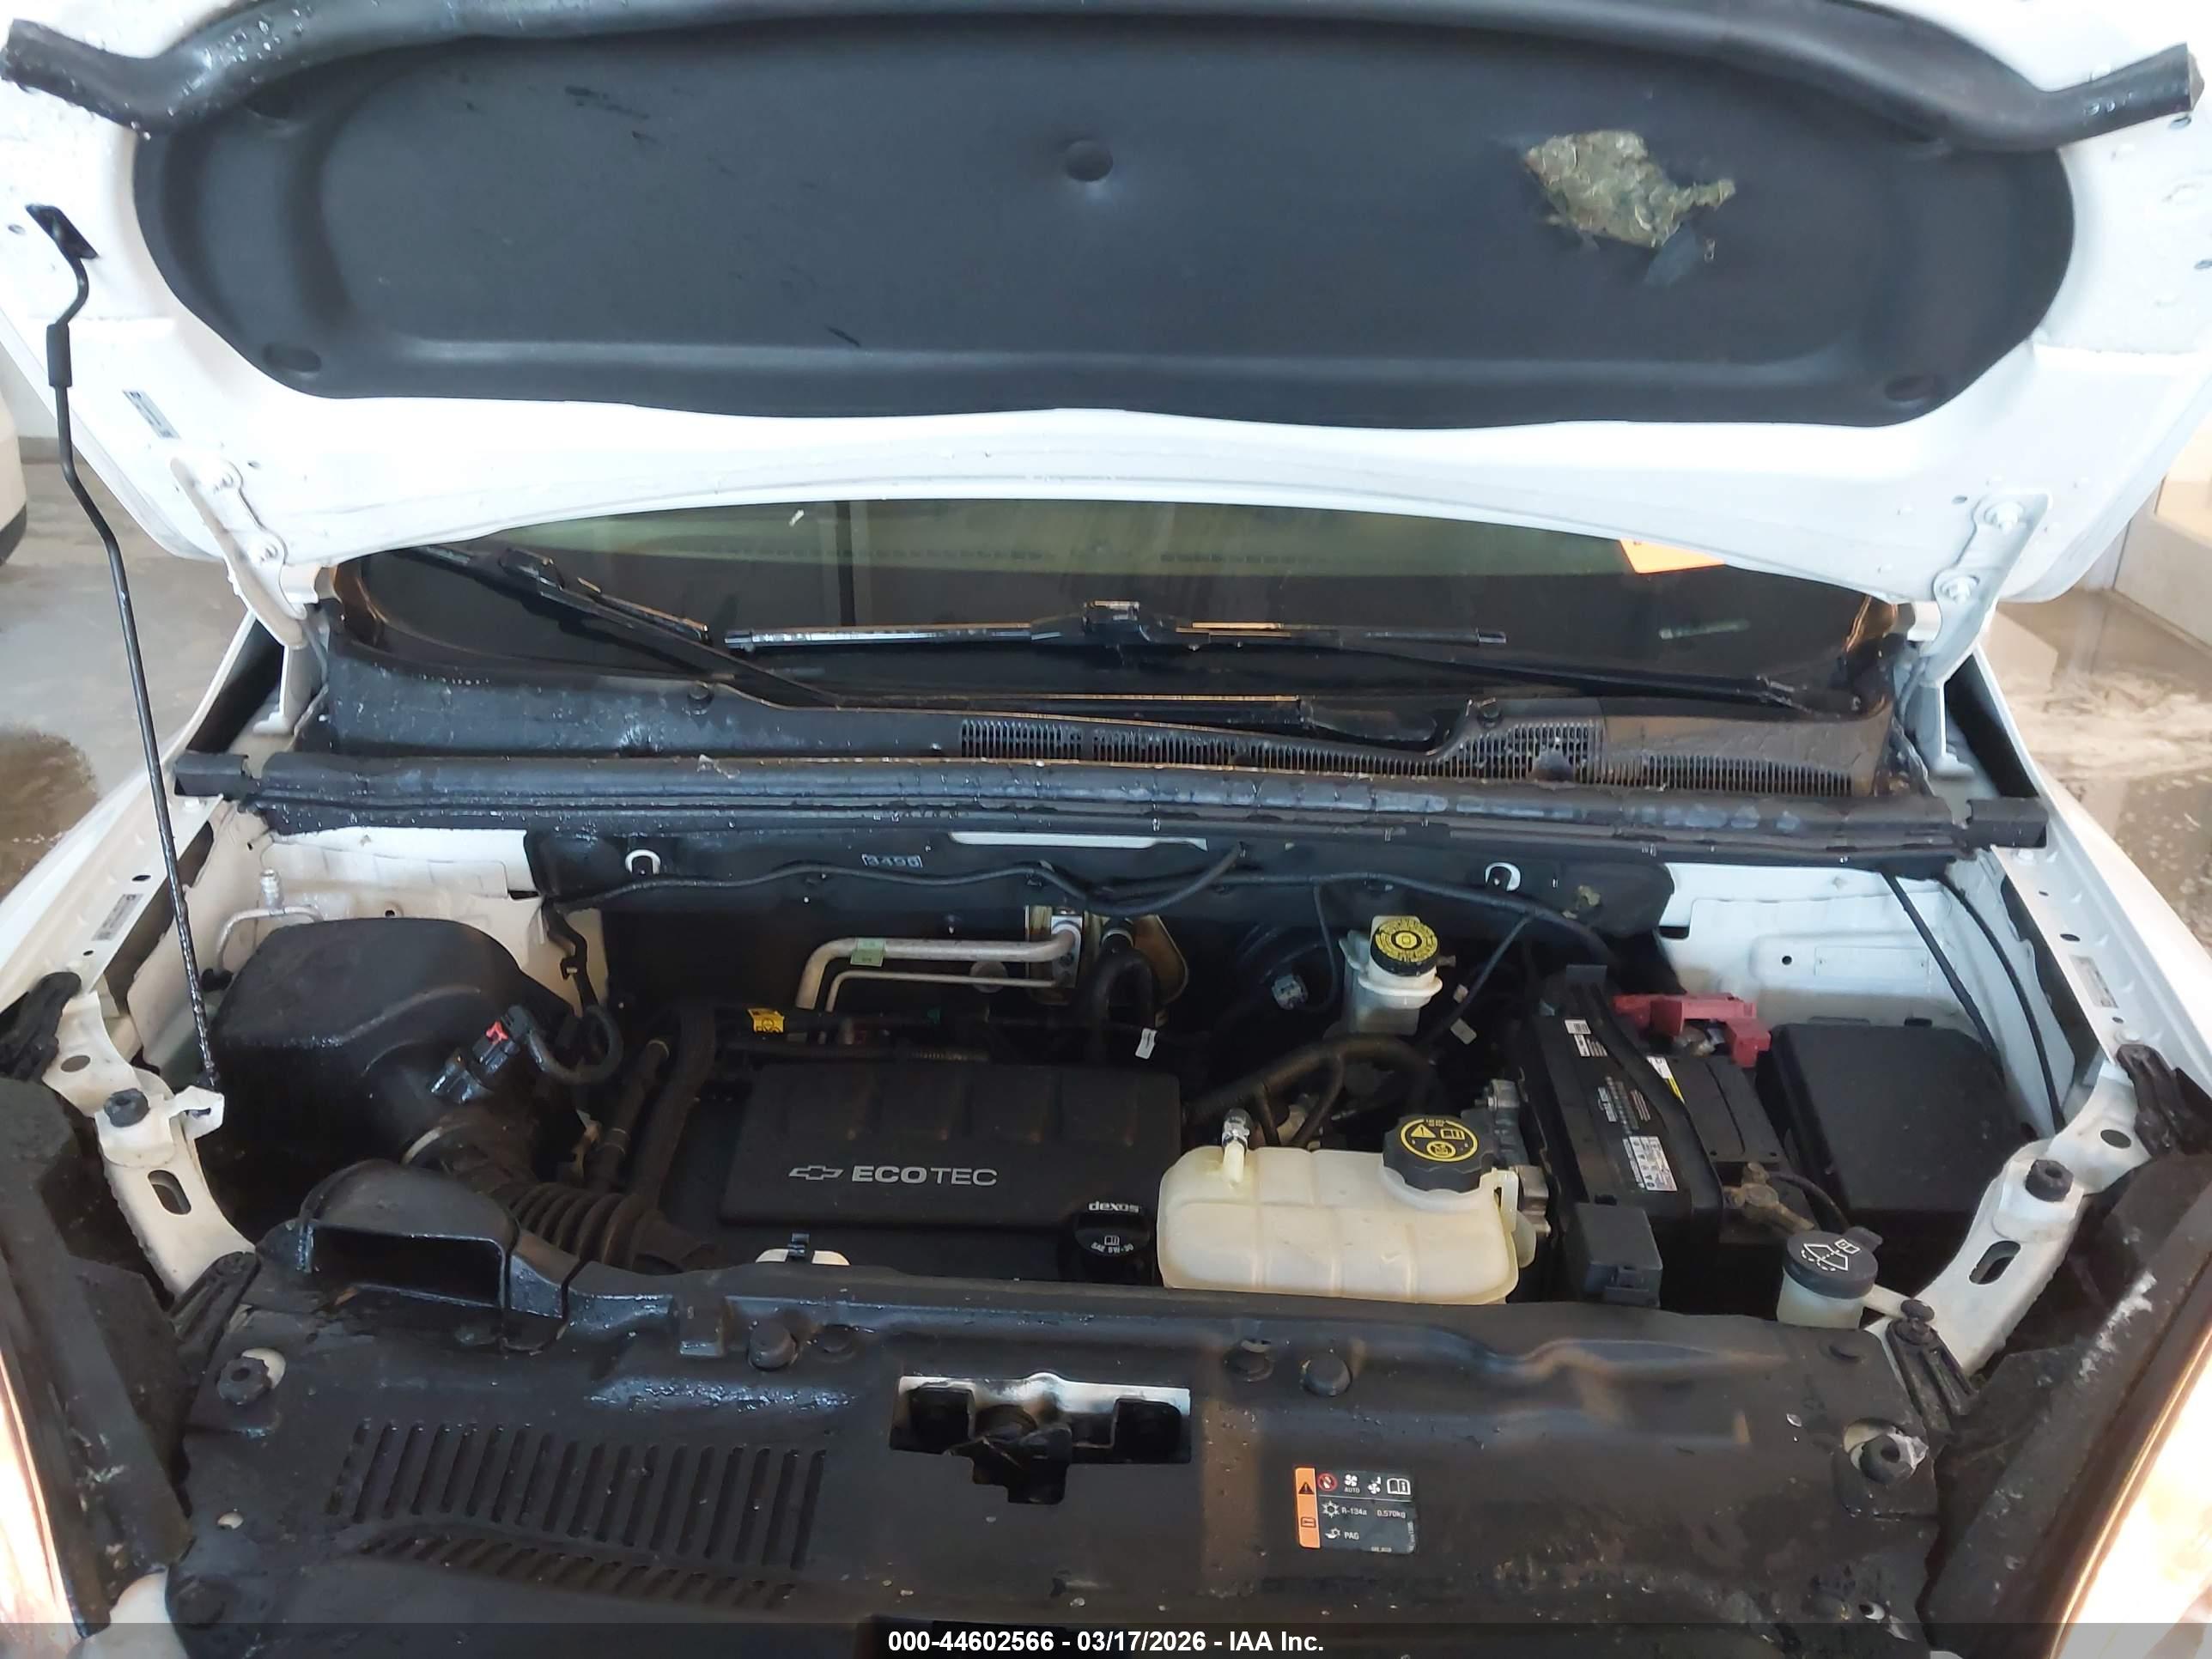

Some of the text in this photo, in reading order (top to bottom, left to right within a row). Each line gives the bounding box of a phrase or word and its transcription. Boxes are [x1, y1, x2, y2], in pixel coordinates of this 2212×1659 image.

[852, 1165, 997, 1186] ECOTEC
[1089, 1201, 1139, 1213] dexos
[1341, 1507, 1367, 1516] R-134a
[1344, 1531, 1359, 1540] PAG
